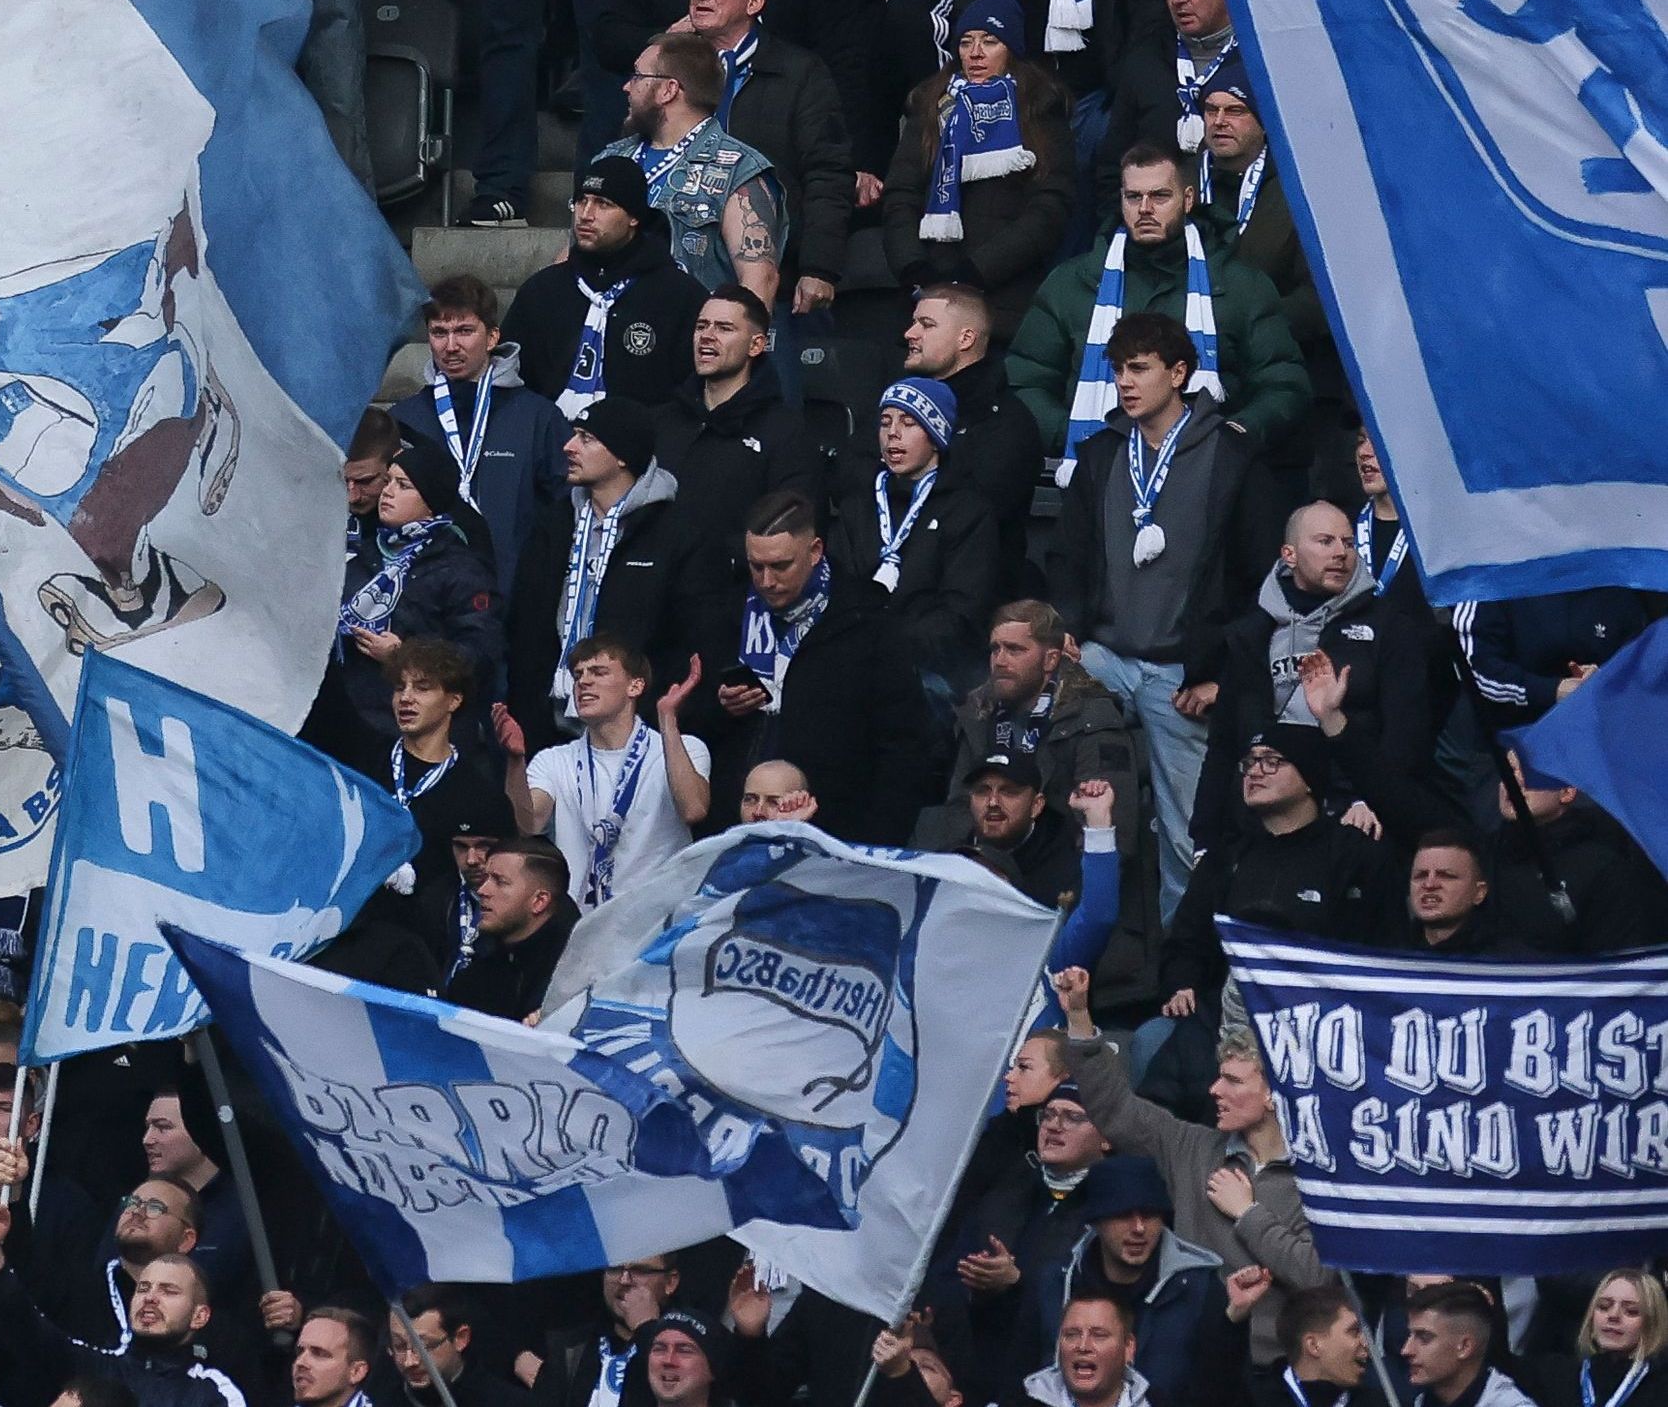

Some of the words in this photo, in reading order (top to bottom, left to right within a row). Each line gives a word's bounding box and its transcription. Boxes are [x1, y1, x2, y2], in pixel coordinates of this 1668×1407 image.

[104, 694, 207, 875] H
[1253, 1001, 1365, 1093] WO
[1384, 1006, 1488, 1096] DU
[1348, 1095, 1520, 1180] SIND
